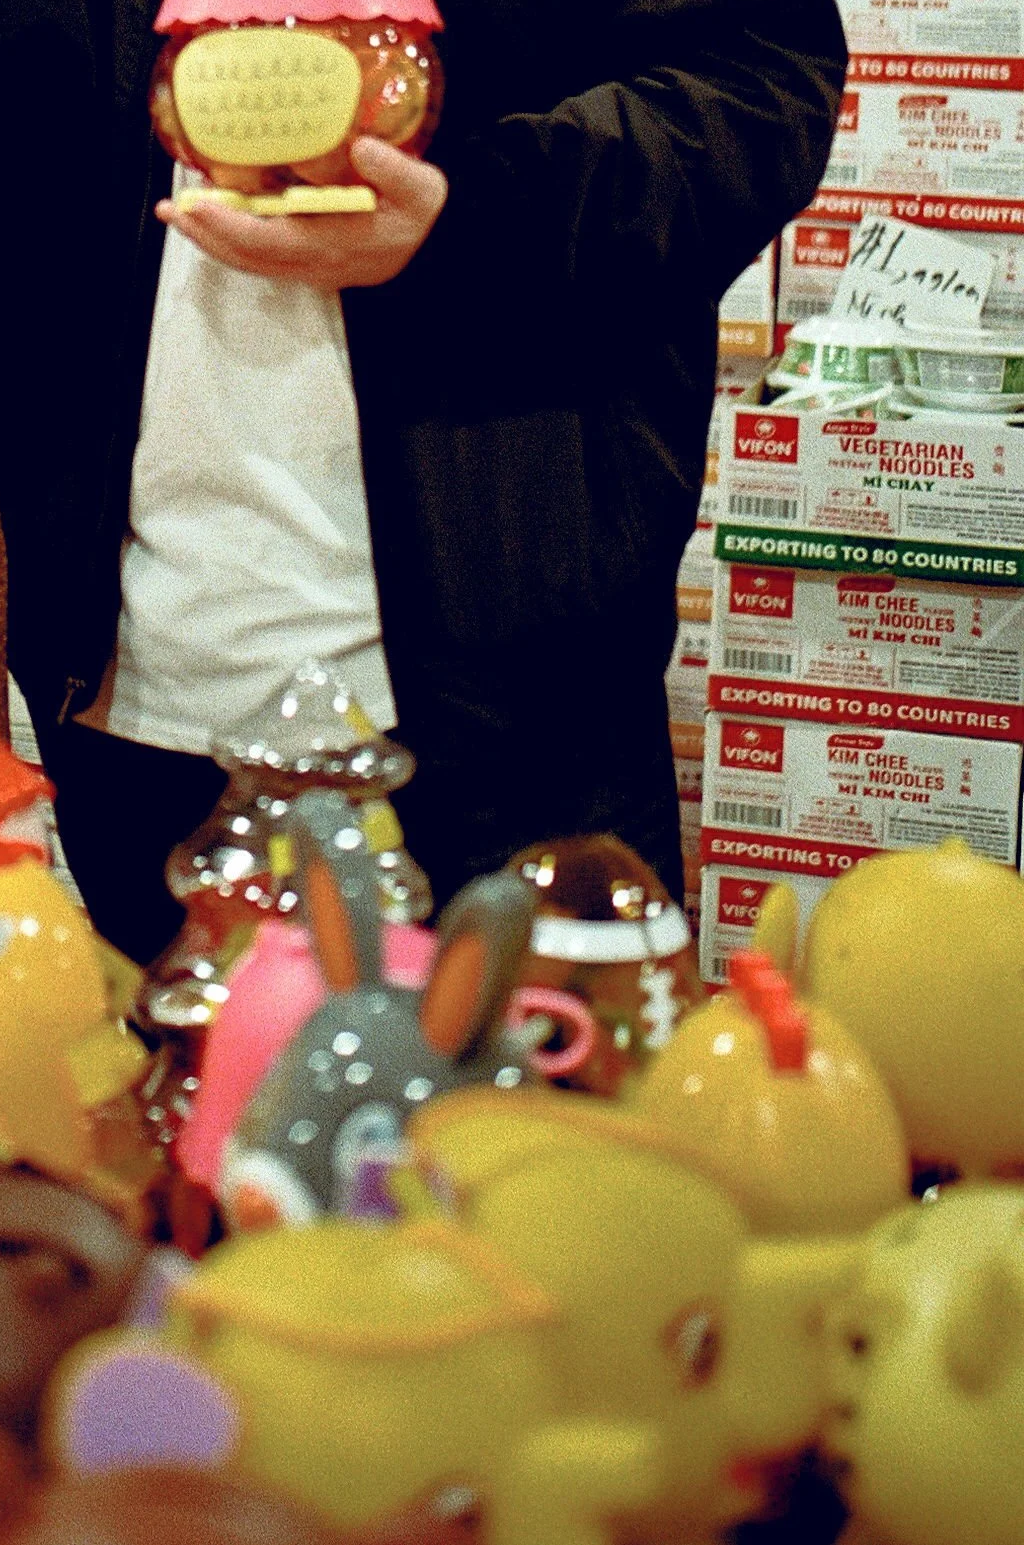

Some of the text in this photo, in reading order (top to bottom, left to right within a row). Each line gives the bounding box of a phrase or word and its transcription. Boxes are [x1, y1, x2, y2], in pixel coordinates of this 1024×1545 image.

[859, 60, 883, 76] TO
[885, 61, 909, 77] 80
[911, 61, 1011, 81] COUNTRIES
[896, 200, 920, 217] TO
[922, 202, 946, 218] 80
[737, 439, 793, 457] VIFON
[839, 437, 964, 461] VEGETARIAN
[828, 459, 873, 470] INSTANT
[879, 457, 975, 479] NOODLES
[887, 477, 935, 493] CHAY
[724, 534, 1018, 576] EXPORTING TO 80 COUNTRIES
[733, 592, 787, 610] VIFON
[837, 592, 870, 608] KIM
[875, 596, 920, 613] CHEE
[879, 612, 955, 634] NOODLES
[872, 629, 906, 644] KIM
[910, 633, 941, 647] CHI
[720, 686, 1011, 730] EXPORTING TO 80 COUNTRIES
[724, 745, 777, 765] VIFON
[828, 748, 859, 765] KIM
[865, 752, 909, 771] CHEE
[869, 771, 945, 791] NOODLES
[862, 787, 896, 801] KIM
[899, 790, 931, 804] CHI
[711, 839, 852, 869] EXPORTING TO
[722, 903, 760, 920] VIFO
